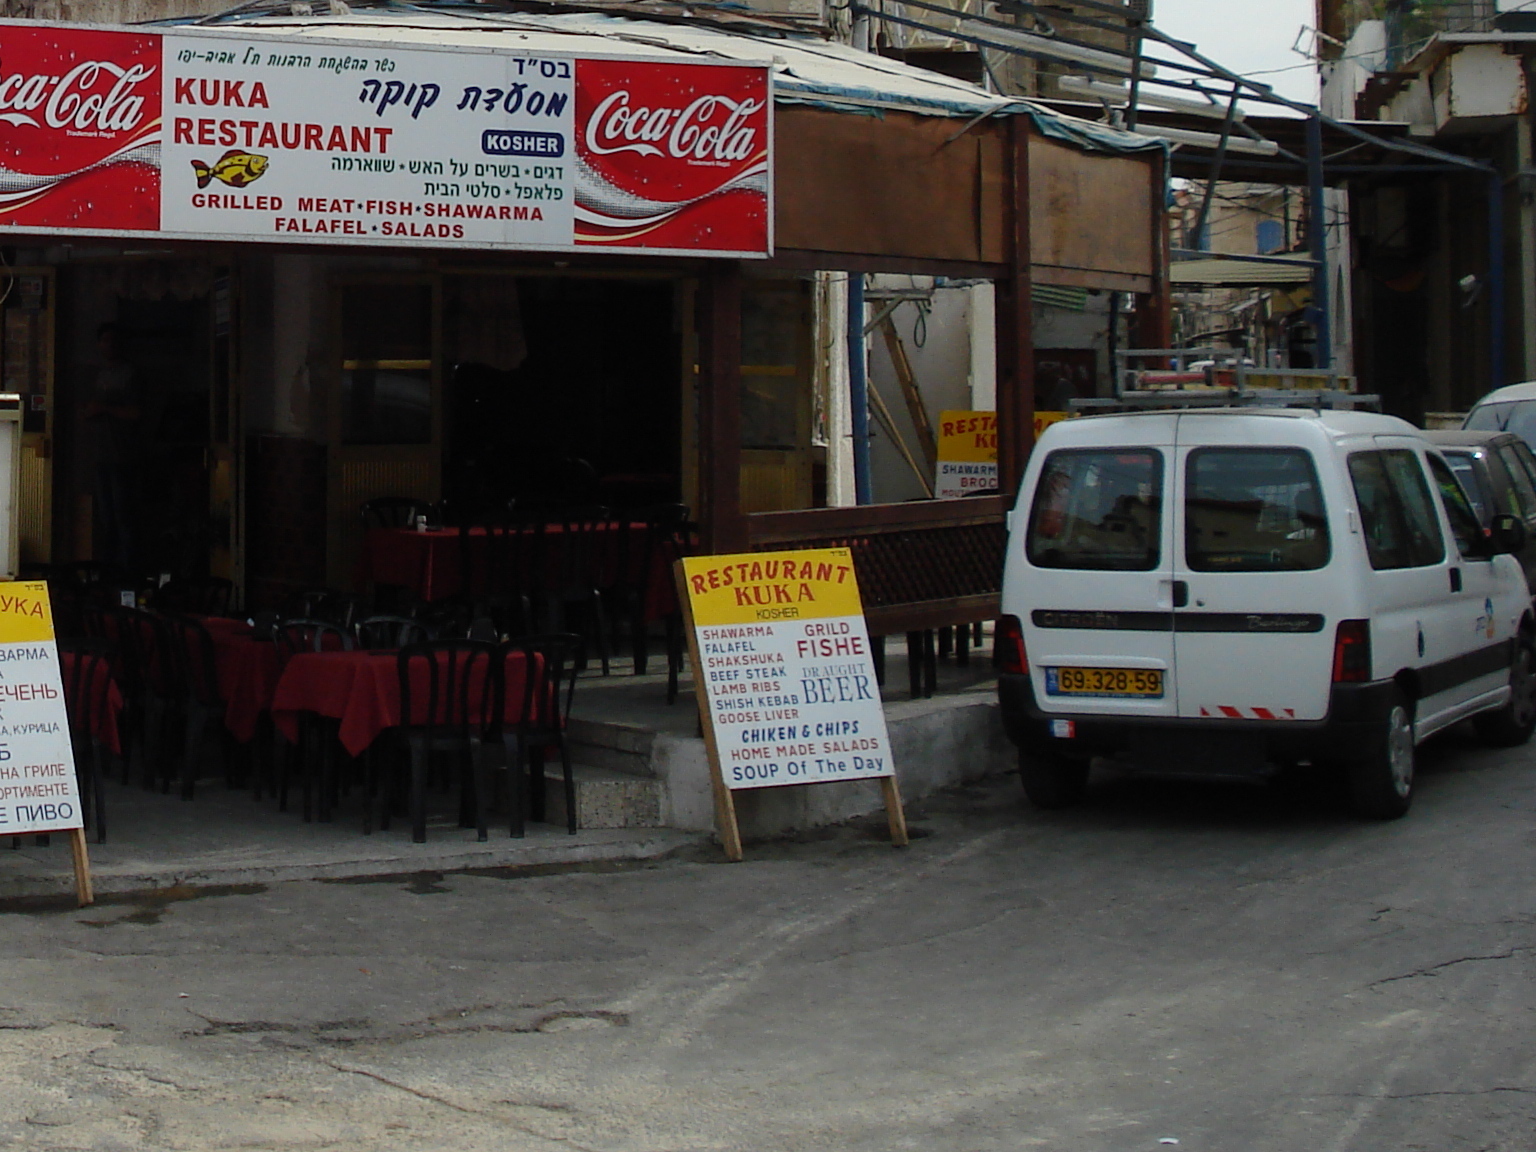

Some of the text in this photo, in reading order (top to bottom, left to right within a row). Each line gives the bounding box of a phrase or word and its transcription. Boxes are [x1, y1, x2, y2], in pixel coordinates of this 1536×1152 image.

[242, 46, 261, 65] תל
[267, 53, 312, 68] הרבנות
[318, 55, 368, 75] בהשגחת
[374, 58, 396, 73] כשר
[174, 77, 270, 109] KUKA
[359, 78, 568, 120] מסעדת קוקה
[585, 90, 766, 160] Coca-Cola
[174, 117, 393, 154] RESTAURANT
[487, 134, 559, 152] KOSHER
[331, 157, 563, 180] דגים בשרים על האש שווארמה
[424, 181, 563, 200] פלאפל סלטי הבית
[192, 193, 544, 221] GRILLED MEAT FISH SHAWARMA
[275, 217, 465, 238] FALAFEL SALADS
[942, 464, 997, 476] SHAWARM
[690, 560, 850, 595] RESTAURANT
[734, 582, 815, 607] KUKA
[756, 607, 799, 620] KOSHER
[703, 626, 774, 640] SHAWARMA
[805, 622, 850, 637] GRILD
[705, 641, 756, 655] FALAFEL
[797, 637, 864, 659] FISHE
[708, 653, 784, 668] SHAKSHUKA
[710, 666, 787, 682] BEEF STEAK
[802, 663, 866, 678] DRAUGHT
[713, 680, 781, 696] LAMB RIBS
[800, 675, 874, 705] BEER
[716, 694, 799, 710] SHISH KEBAB
[718, 709, 799, 724] GOOSE LIVER
[13, 722, 61, 734] КУРИЦА
[742, 720, 859, 743] CHIKEN & CHIPS
[731, 738, 879, 761] HOME MADE SALADS
[0, 766, 20, 780] НА
[24, 763, 66, 778] ГРИЛЕ
[732, 755, 884, 781] SOUP Of The Day
[16, 802, 73, 823] ПИВО
